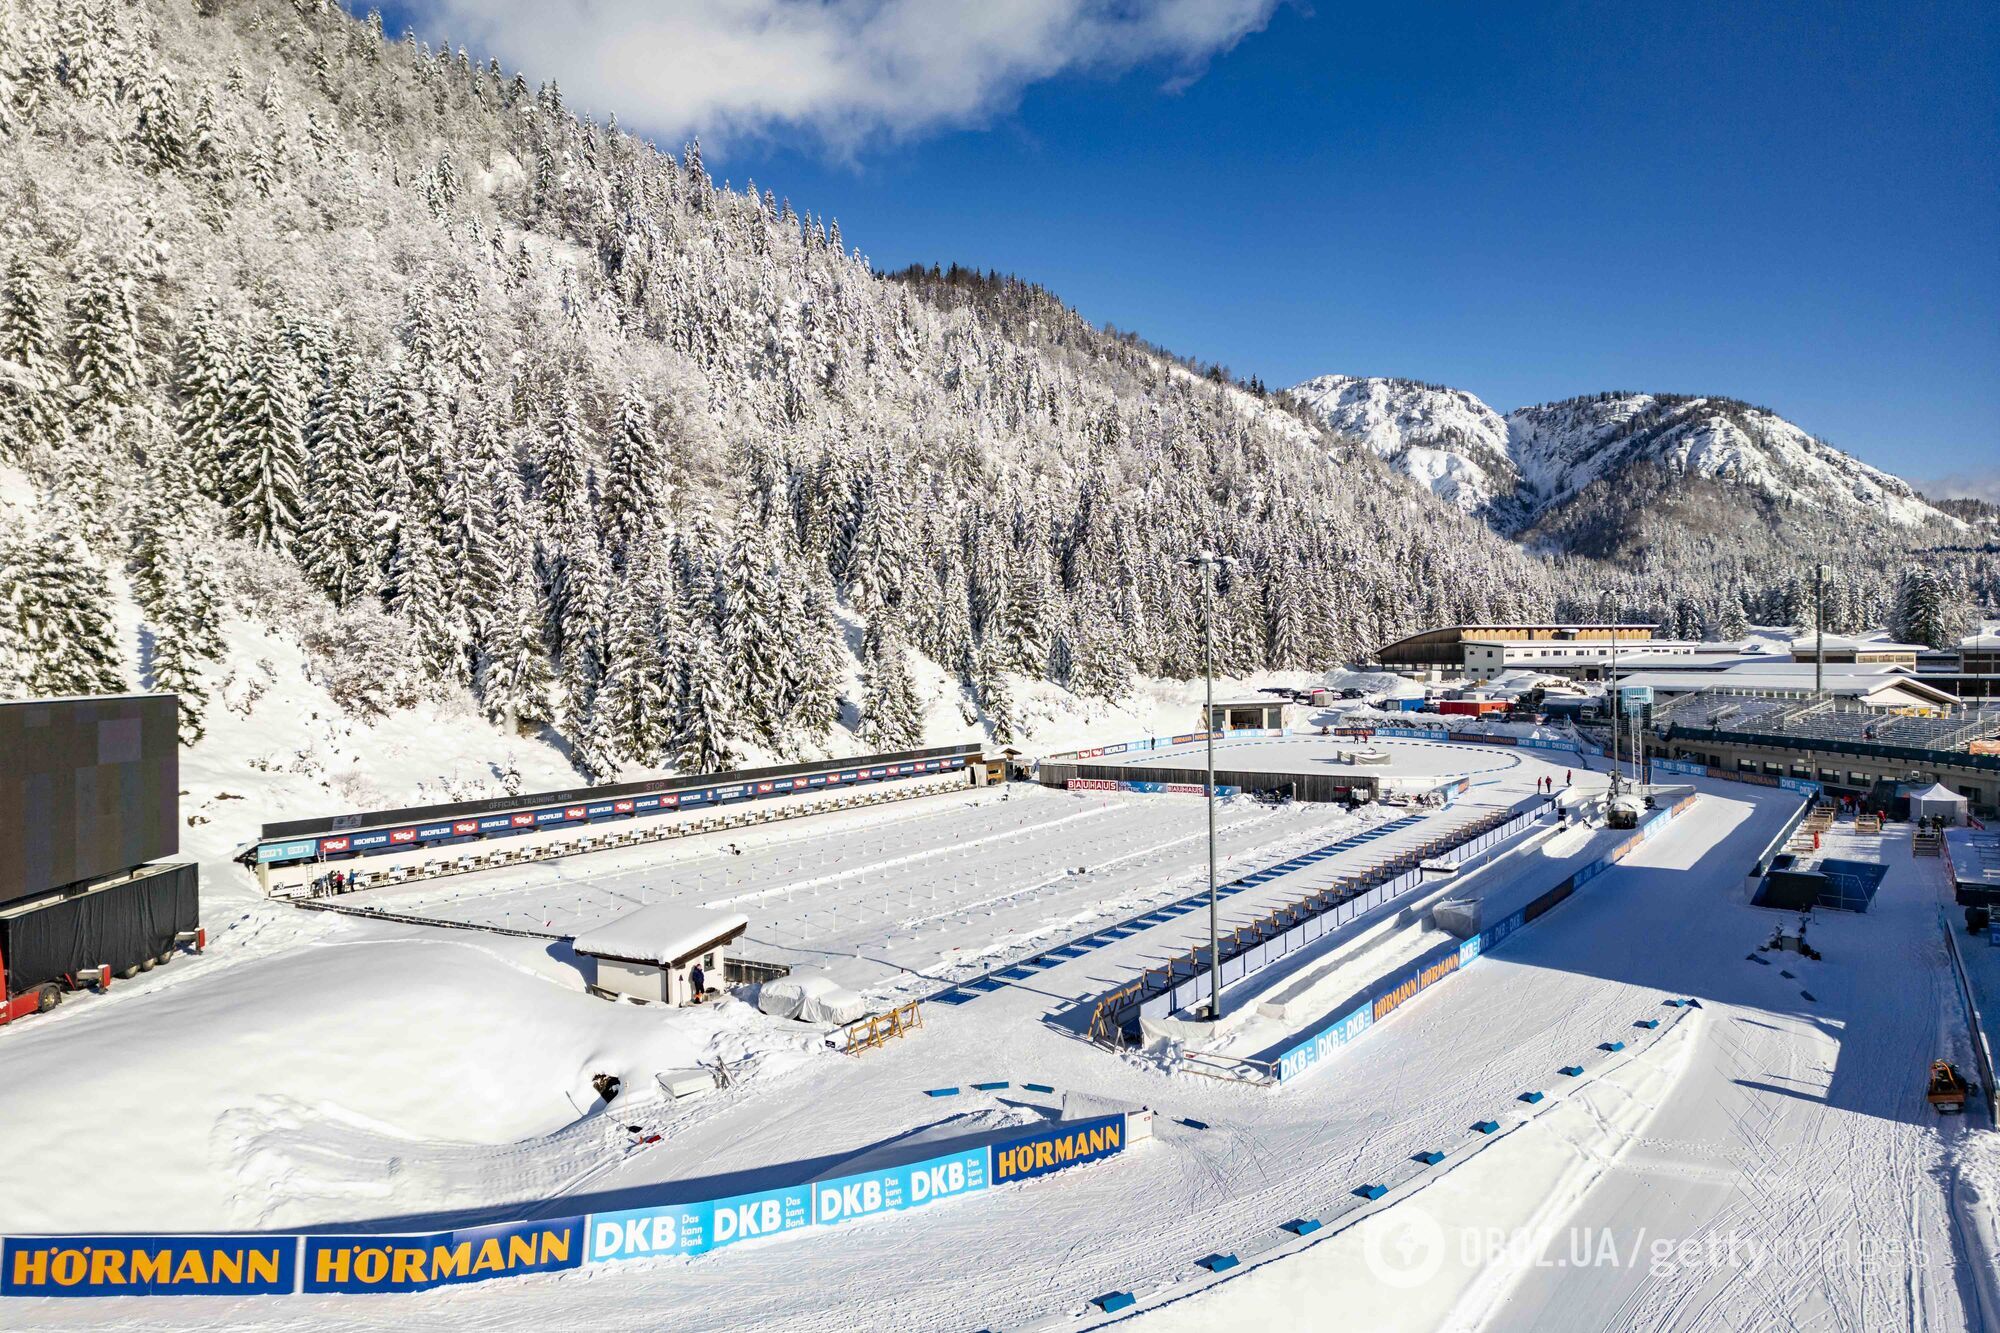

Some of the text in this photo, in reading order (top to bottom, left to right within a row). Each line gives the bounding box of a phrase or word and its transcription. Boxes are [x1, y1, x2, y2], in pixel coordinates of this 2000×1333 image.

[646, 782, 664, 790] STOP
[1068, 780, 1116, 791] BAUHAUS
[1782, 778, 1796, 788] DKB
[1168, 786, 1203, 794] BAUHAUS
[488, 798, 519, 810] OFFICIAL
[524, 795, 555, 805] TRAINING
[420, 827, 450, 836] HOCHFILZEN
[354, 836, 386, 846] HOCHFILZEN
[1510, 913, 1521, 930] DKB
[1460, 942, 1474, 964] DKB
[1375, 978, 1417, 1020] HÖRMANN
[1346, 1012, 1365, 1040] DKB
[1318, 1030, 1339, 1057] DKB
[1282, 1050, 1307, 1079] DKB
[998, 1124, 1120, 1178] HÖRMANN
[967, 1159, 980, 1168] Das
[968, 1168, 982, 1176] kann
[885, 1178, 898, 1187] Das
[911, 1162, 965, 1202] DKB
[968, 1178, 982, 1187] Bank
[886, 1188, 902, 1197] kann
[786, 1197, 800, 1206] Das
[821, 1180, 882, 1221] DKB
[885, 1197, 902, 1207] Bank
[786, 1208, 804, 1218] kann
[682, 1214, 699, 1224] Das
[714, 1200, 782, 1242] DKB
[786, 1218, 804, 1228] Bank
[682, 1226, 702, 1235] kann
[594, 1216, 677, 1258] DKB
[680, 1236, 702, 1246] Bank
[316, 1228, 570, 1284] HÖRMANN
[13, 1246, 280, 1286] HÖRMANN
